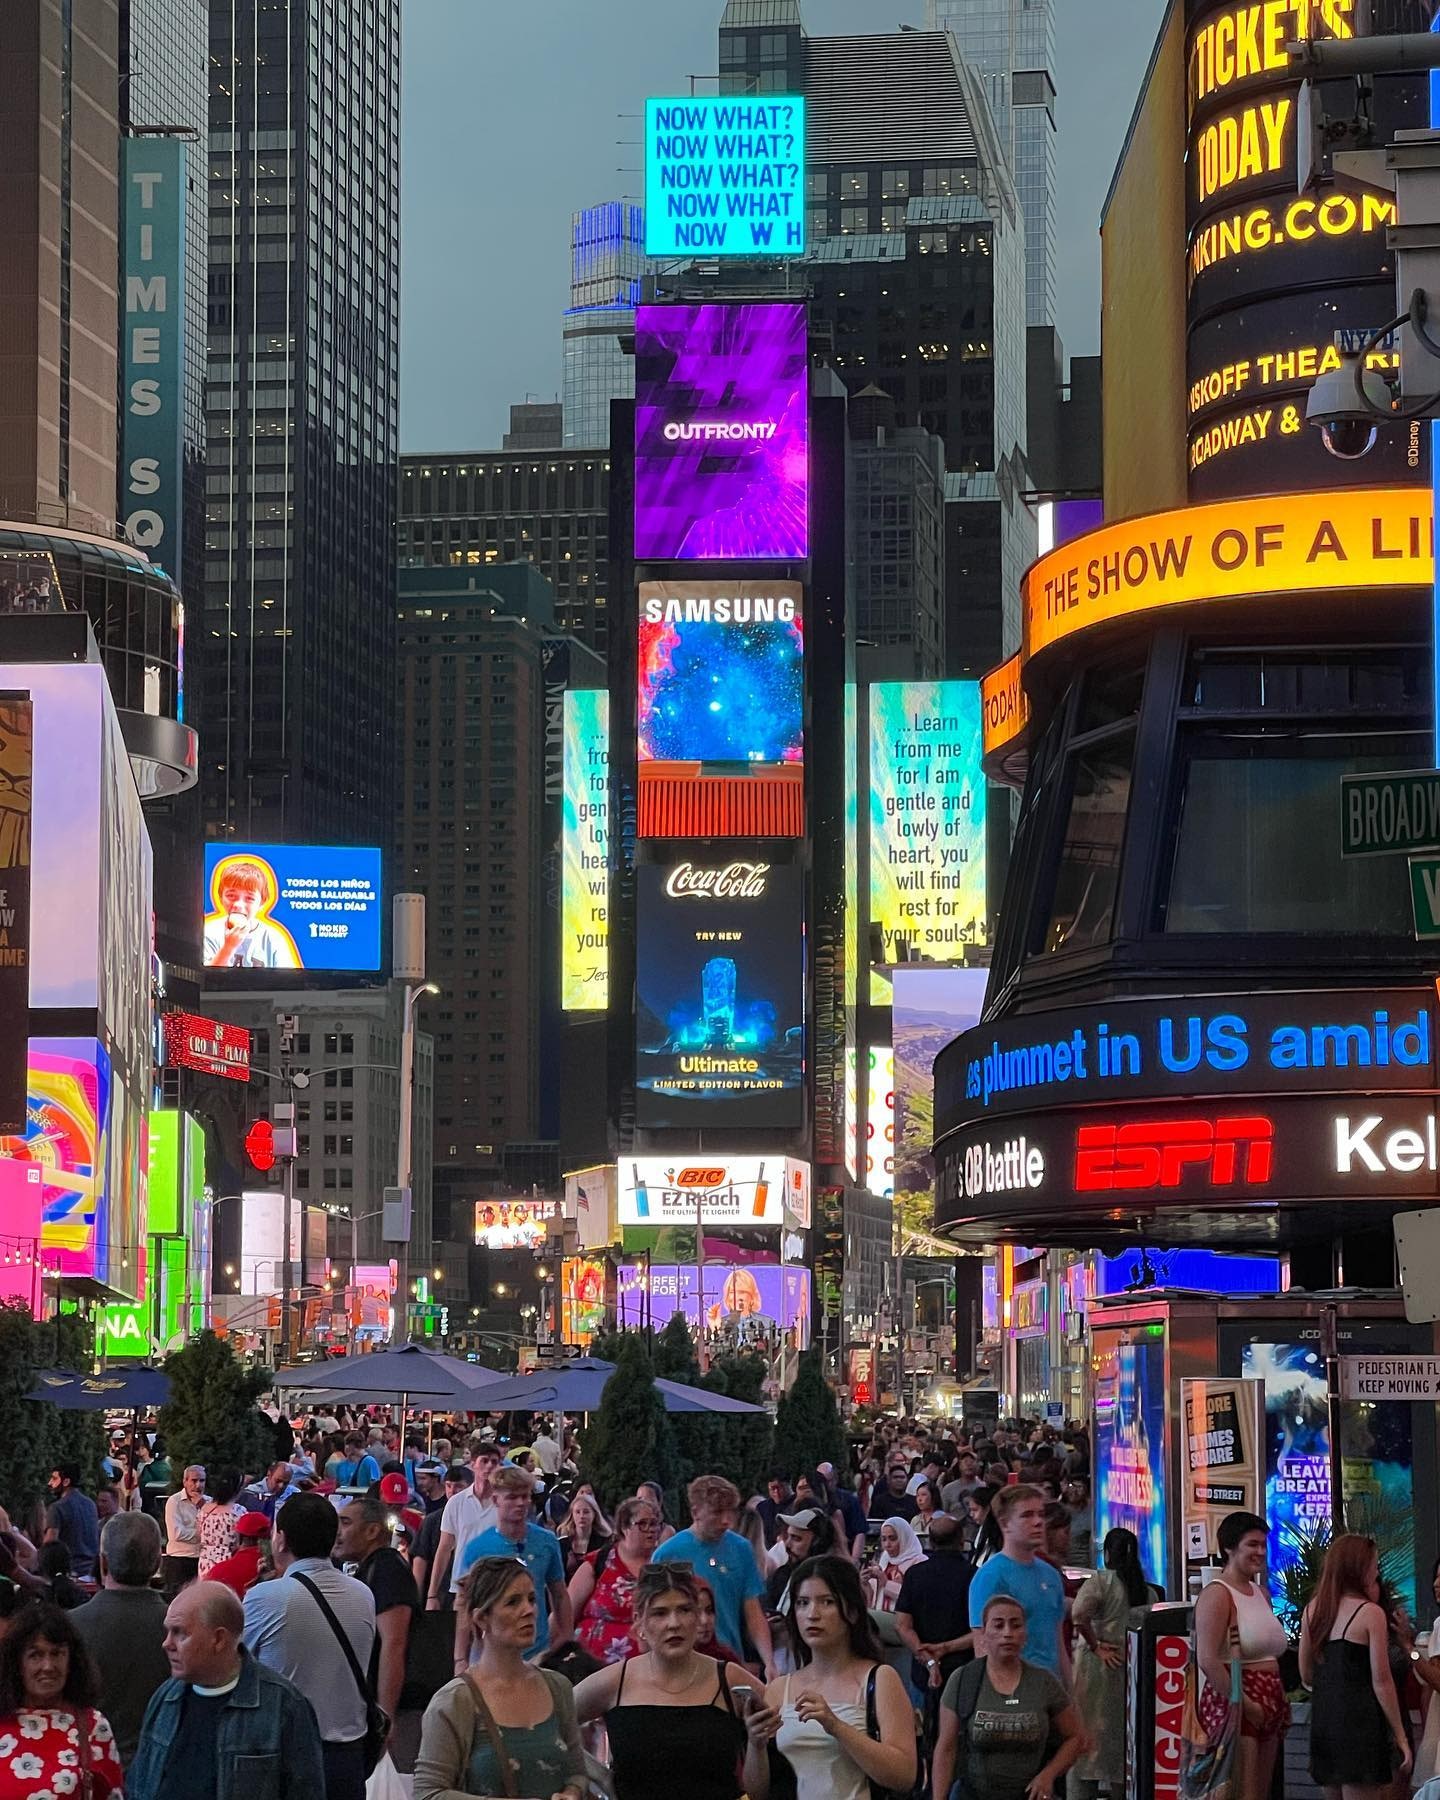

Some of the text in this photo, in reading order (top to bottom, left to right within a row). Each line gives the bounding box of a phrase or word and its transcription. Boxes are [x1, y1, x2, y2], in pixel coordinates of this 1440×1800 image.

[656, 105, 794, 131] NOW WHAT?
[656, 134, 794, 160] NOW WHAT?
[1199, 99, 1291, 203] TODAY
[661, 163, 799, 189] NOW WHAT?
[667, 192, 793, 218] NOW WHAT
[675, 222, 727, 247] NOW
[126, 172, 167, 417] TIMES
[1280, 406, 1300, 434] &
[1044, 567, 1079, 621] THE
[1087, 534, 1193, 600] SHOW
[1210, 524, 1285, 571] OF
[1305, 520, 1348, 563] A
[645, 597, 795, 624] SAMSUNG
[985, 679, 1018, 733] TODAY
[914, 713, 959, 733] Learn
[894, 741, 962, 759] from me
[896, 767, 920, 785] for
[935, 769, 960, 785] am
[886, 790, 971, 817] gentle and
[897, 818, 961, 843] lowly of
[888, 844, 968, 868] heart, you
[286, 878, 319, 888] TODOS
[320, 879, 339, 889] LOS
[666, 861, 771, 898] Coca-Cola
[896, 869, 961, 890] will find
[281, 889, 376, 900] COMIDA SALUDABLE
[290, 900, 322, 910] TODOS
[324, 901, 342, 911] LOS
[899, 896, 959, 916] rest for
[695, 931, 742, 941] TRY NEW
[884, 927, 920, 948] your
[680, 1056, 759, 1074] Ultimate
[983, 1027, 1088, 1106] plummet
[1098, 1023, 1141, 1077] in
[1158, 1013, 1249, 1074] US
[1269, 1009, 1430, 1069] amid
[653, 1080, 784, 1089] LIMITED EDITION FLAVOR
[985, 1136, 1045, 1193] battle
[1073, 1116, 1276, 1192] ESPN
[662, 1191, 682, 1207] EZ
[1358, 1361, 1424, 1375] PEDESTRIAN
[1358, 1380, 1430, 1393] KEEP MOVING
[1213, 1489, 1243, 1501] STREET
